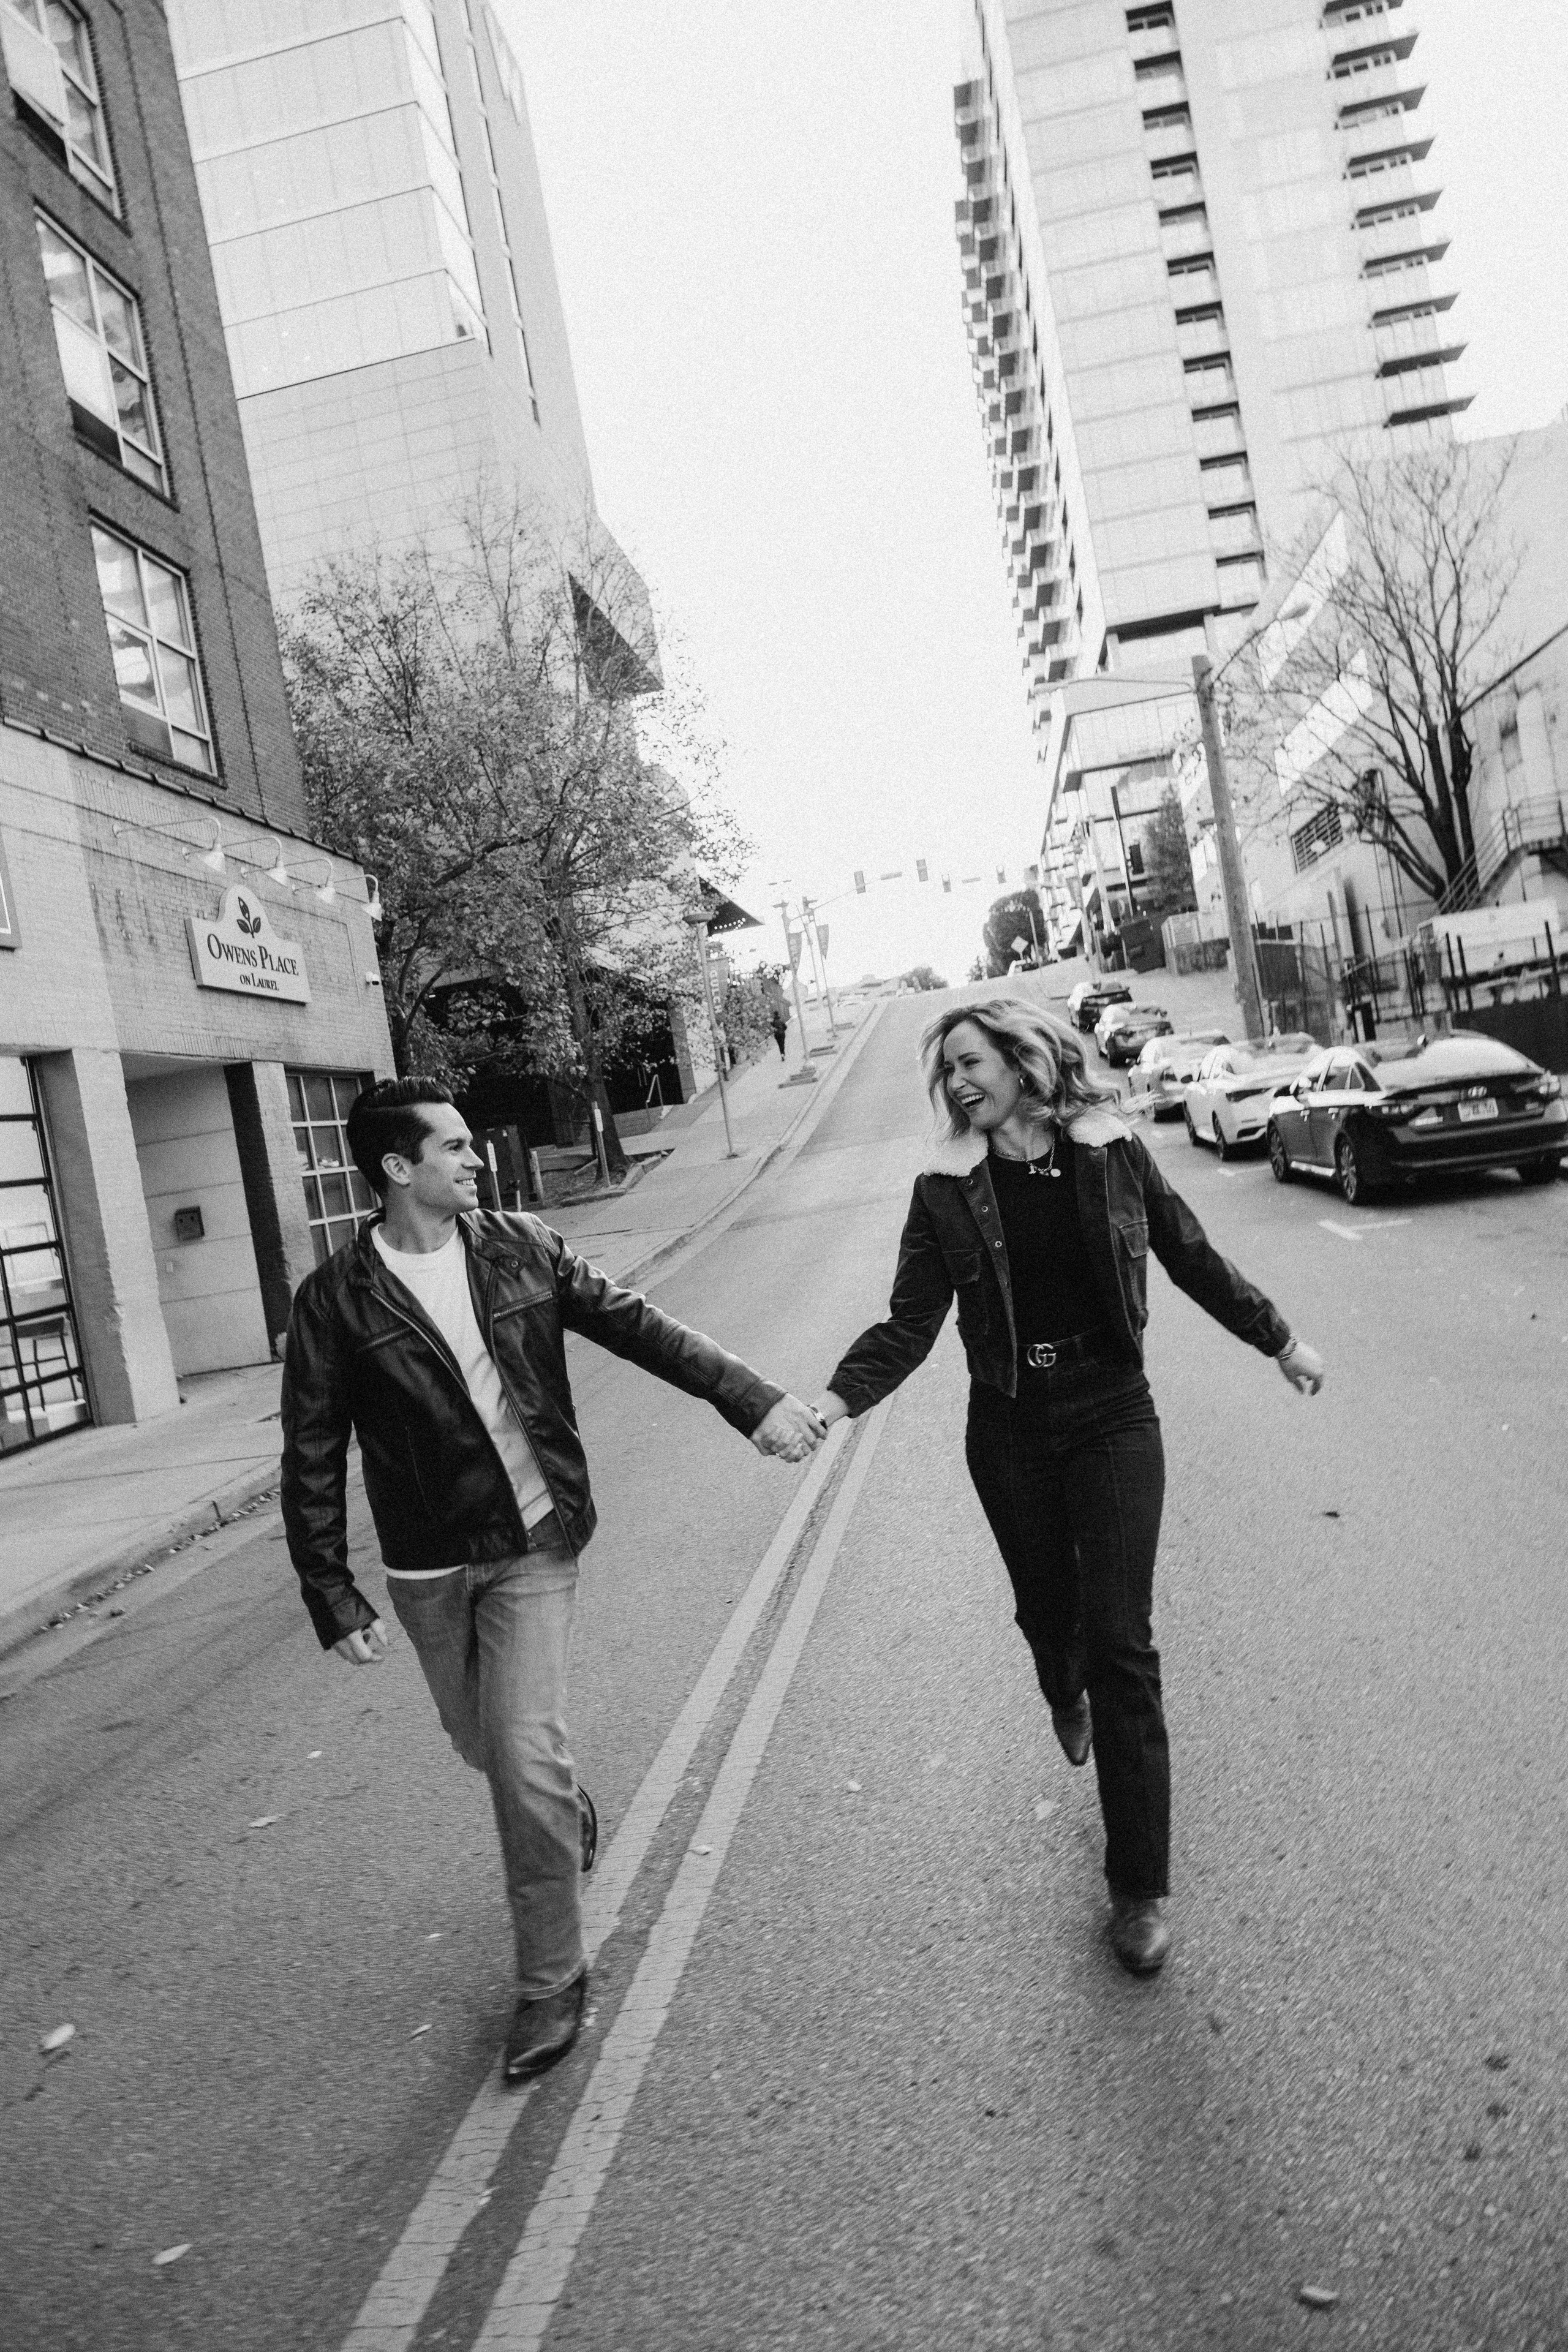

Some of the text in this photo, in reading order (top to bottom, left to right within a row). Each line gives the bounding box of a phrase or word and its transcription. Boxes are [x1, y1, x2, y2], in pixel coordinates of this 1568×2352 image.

[207, 933, 299, 976] OWENS PLACE
[251, 973, 279, 991] LAUREL
